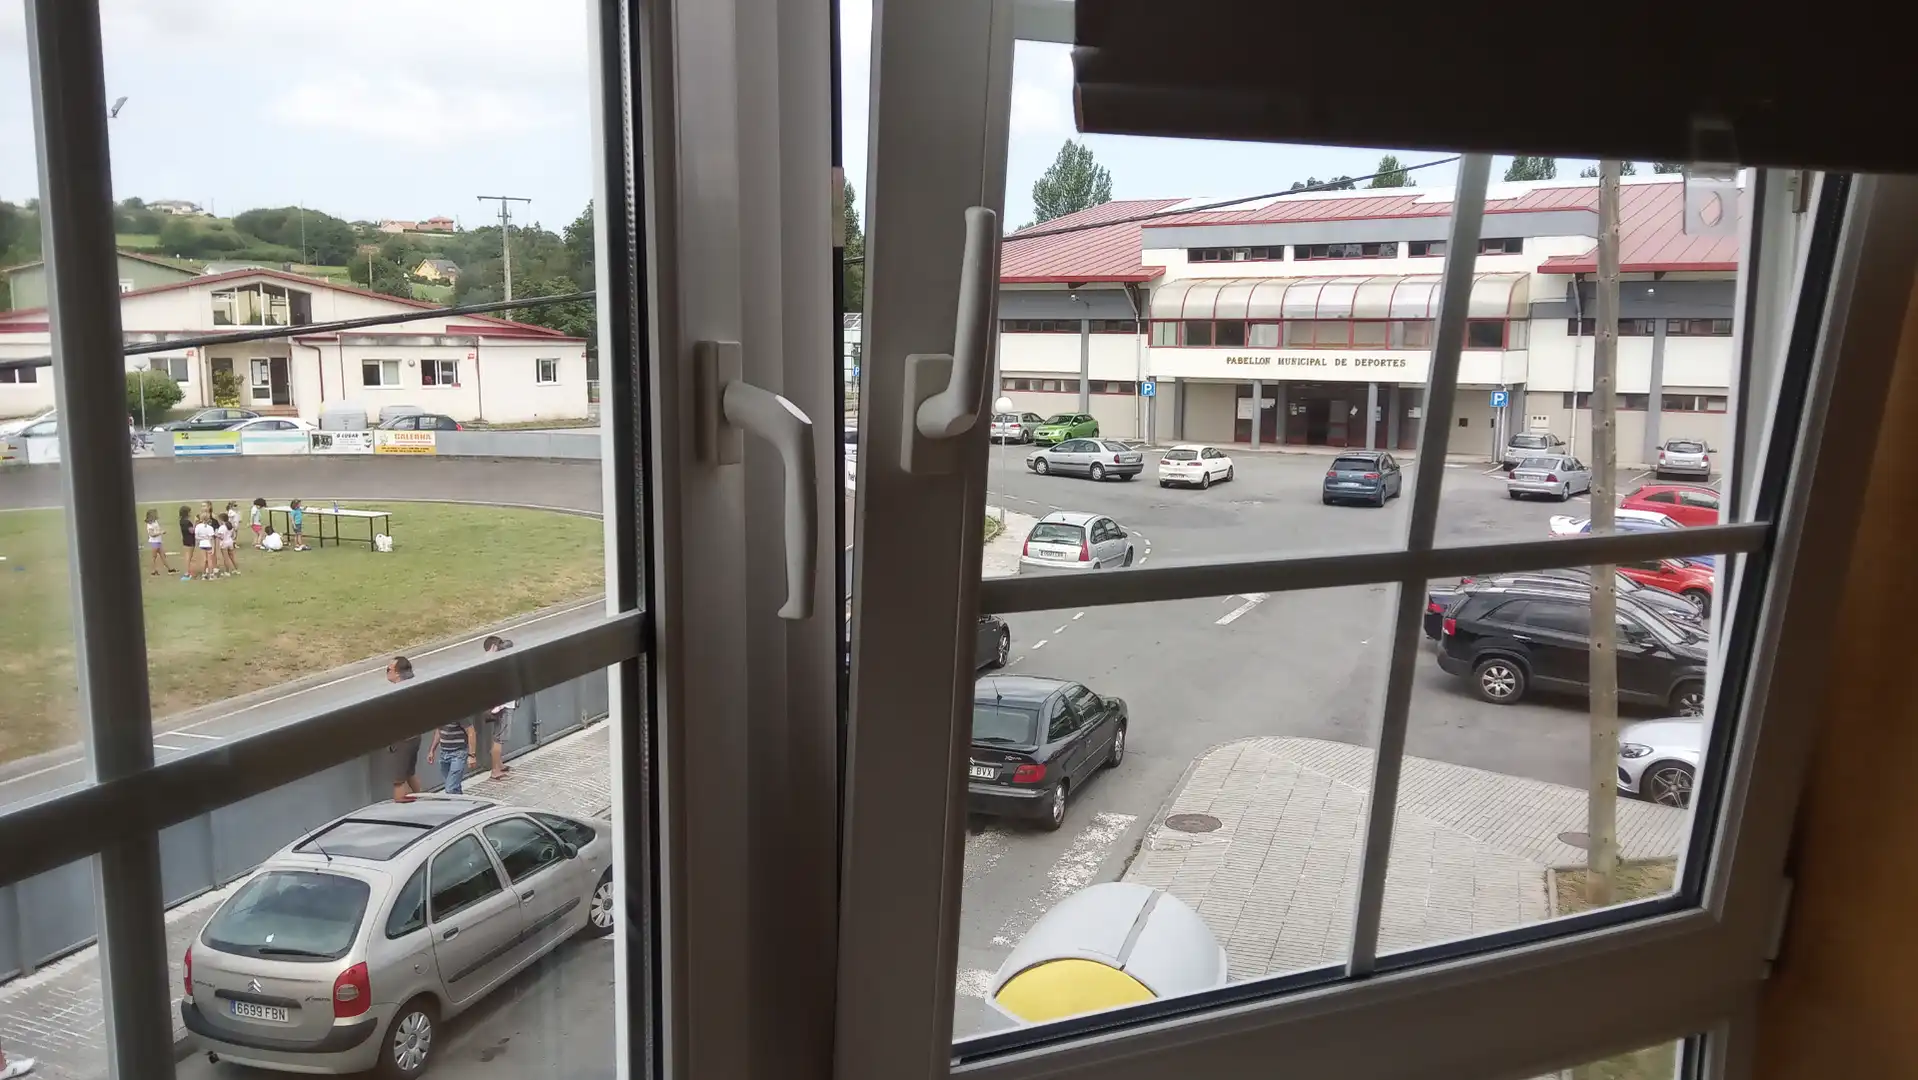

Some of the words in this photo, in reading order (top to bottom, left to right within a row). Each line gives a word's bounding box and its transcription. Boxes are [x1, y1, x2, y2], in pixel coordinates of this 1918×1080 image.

[1226, 357, 1271, 365] PABELLON
[1278, 357, 1327, 366] MUNICIPAL
[1335, 358, 1348, 366] DE
[1354, 358, 1406, 367] DEPORTES
[1144, 383, 1152, 395] P
[1494, 392, 1505, 405] P
[976, 767, 992, 777] BVX
[237, 1002, 262, 1017] 6699
[265, 1006, 286, 1021] FBN
